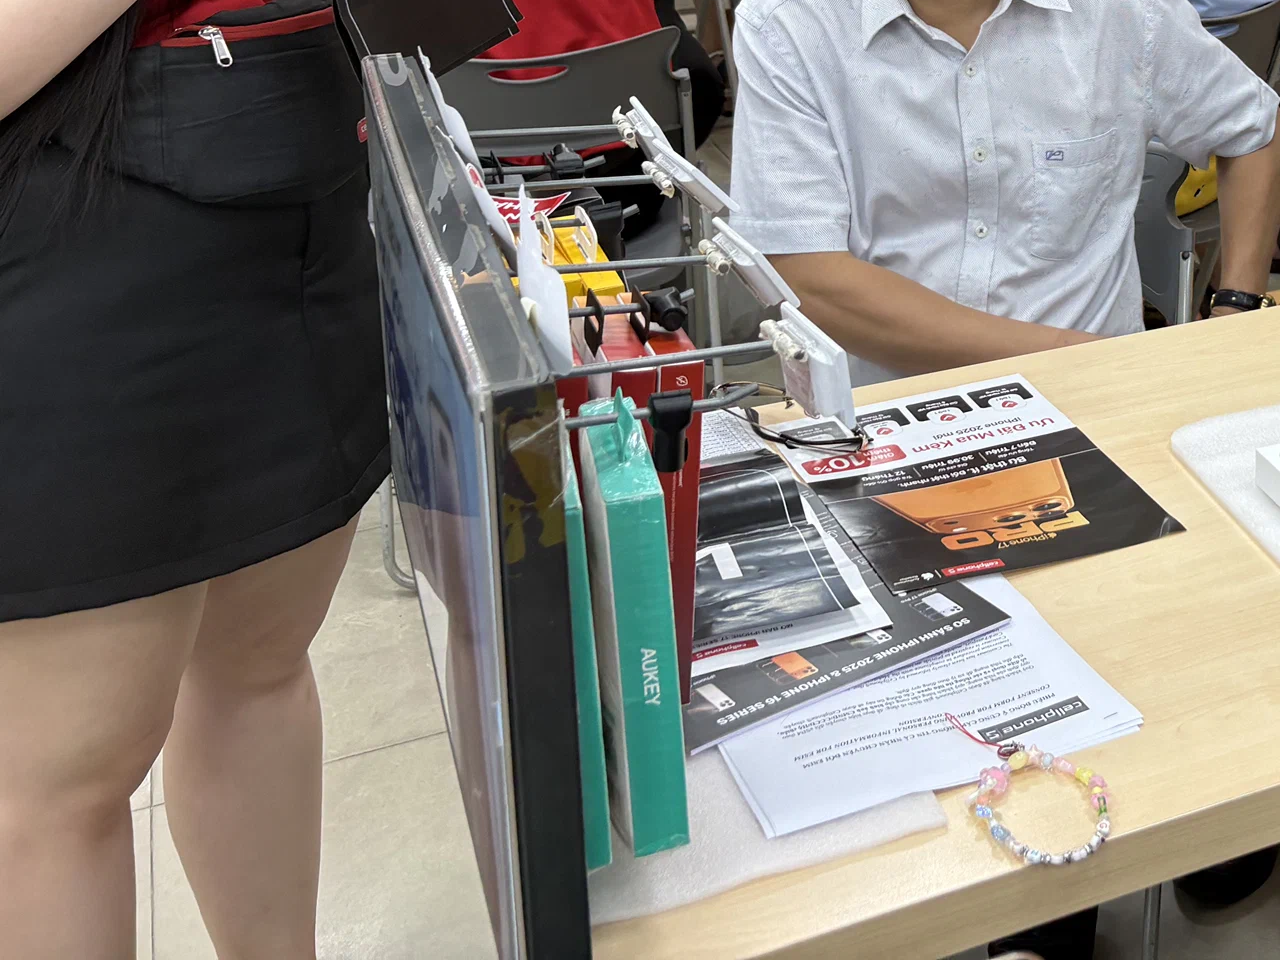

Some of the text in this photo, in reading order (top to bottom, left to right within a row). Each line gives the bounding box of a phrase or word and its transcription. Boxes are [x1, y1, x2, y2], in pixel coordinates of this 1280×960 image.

[954, 425, 983, 438] 2025
[983, 416, 1022, 433] iPhone
[911, 416, 1055, 456] Ưu Đãi Mua Kèm
[814, 454, 866, 475] 10%
[941, 510, 1090, 551] PRO
[639, 647, 661, 706] AUKEY
[715, 617, 971, 725] SO SÁNH IPHONE 2025 IPHONE 16 SERIES
[987, 690, 1011, 703] FORM
[1013, 683, 1051, 695] CONSENT
[969, 699, 986, 709] FOR
[1001, 700, 1083, 733] cellphone
[892, 720, 932, 734] PERSONAL
[834, 729, 891, 749] INFORMATION
[816, 744, 832, 754] FOR
